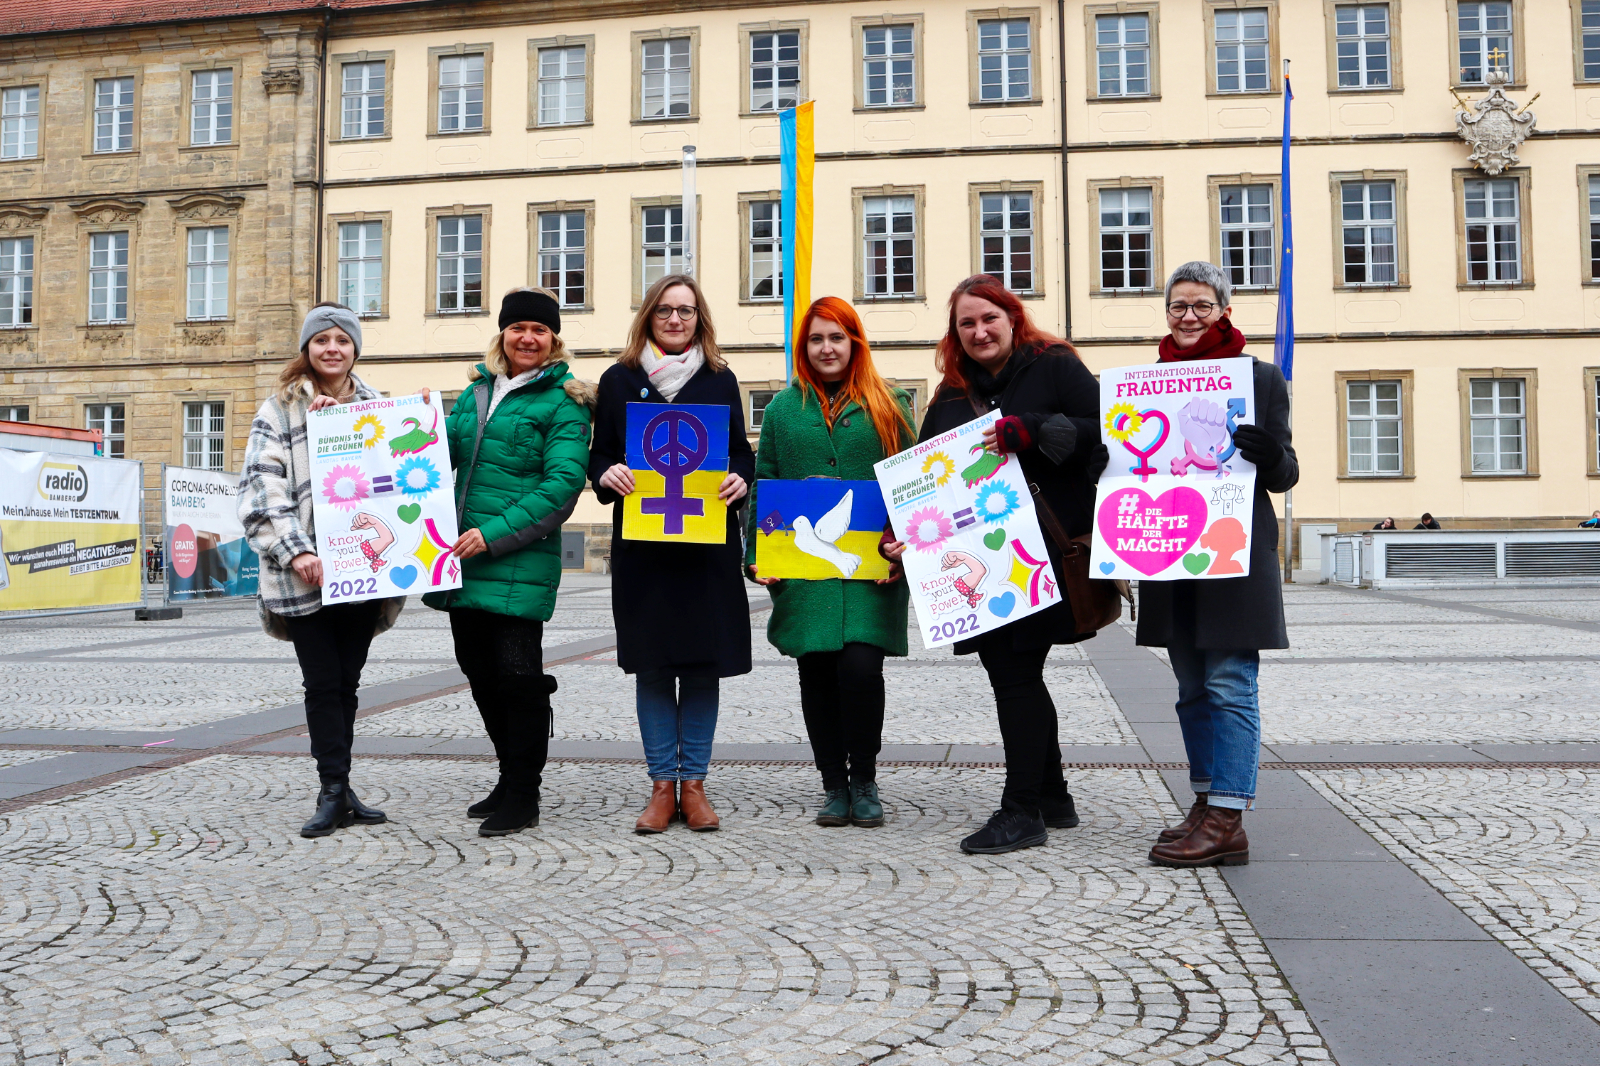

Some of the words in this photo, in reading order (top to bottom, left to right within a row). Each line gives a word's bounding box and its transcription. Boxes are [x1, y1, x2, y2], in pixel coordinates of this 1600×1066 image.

[1124, 365, 1222, 381] INTERNATIONALER
[1116, 375, 1232, 397] FRAUENTAG
[316, 406, 348, 417] GRÜNE
[350, 401, 394, 413] FRAKTION
[317, 445, 329, 454] DIE
[332, 441, 363, 451] GRÜNEN
[318, 434, 352, 445] BÜNDNIS
[883, 451, 913, 470] GRÜNE
[913, 431, 958, 456] FRAKTION
[958, 415, 993, 436] BAYERN
[45, 471, 83, 492] radio
[892, 477, 923, 496] BÜNDNIS
[924, 472, 934, 481] 90
[49, 494, 76, 502] BAMBERG
[893, 496, 905, 505] DIE
[906, 481, 936, 499] GRÜNEN
[171, 495, 206, 509] BAMBERG
[2, 504, 24, 517] Mein
[53, 507, 70, 518] Mein
[70, 508, 121, 520] TESTZENTRUM.
[1145, 508, 1162, 516] DIE
[1116, 512, 1188, 529] HÄLFTE
[327, 534, 364, 547] know
[1142, 529, 1162, 538] DER
[8, 554, 22, 563] Wir
[22, 551, 44, 561] wünschen
[57, 542, 75, 555] HIER
[76, 544, 116, 561] NEGATIVES
[174, 540, 195, 551] GRATIS
[337, 544, 359, 560] your
[1116, 537, 1186, 552] MACHT
[70, 564, 86, 574] BLEIBT
[86, 562, 100, 571] BITTE
[329, 577, 378, 599] 2022
[920, 573, 956, 592] know
[931, 584, 954, 602] your
[929, 613, 980, 642] 2022
